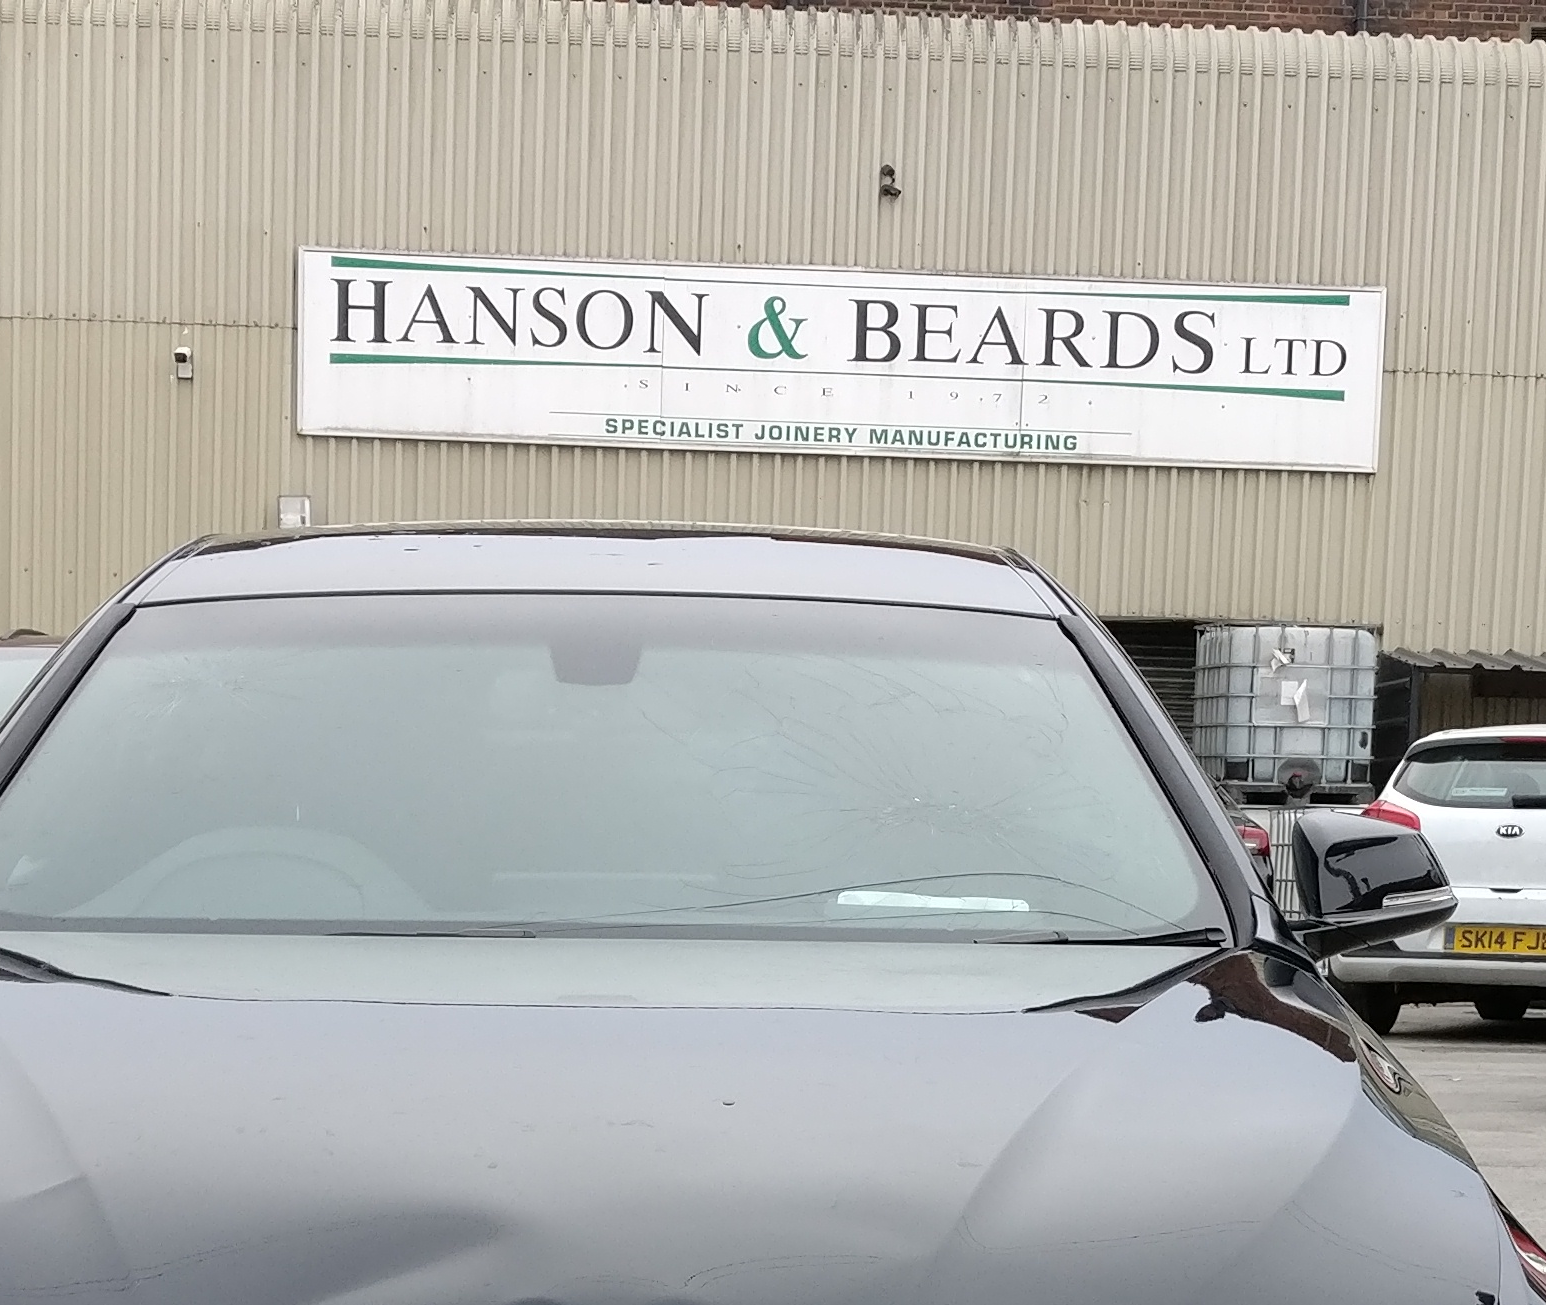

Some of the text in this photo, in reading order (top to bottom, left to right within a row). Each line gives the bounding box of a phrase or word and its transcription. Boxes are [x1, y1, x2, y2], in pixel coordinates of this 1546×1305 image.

[329, 277, 1348, 377] HANSON & BEARDS LTD
[638, 378, 1049, 406] SINCE 1972
[605, 418, 1079, 452] SPECIALIST JOINERY MANUFACTURING
[1499, 826, 1520, 835] KIA
[1461, 929, 1506, 949] SK14
